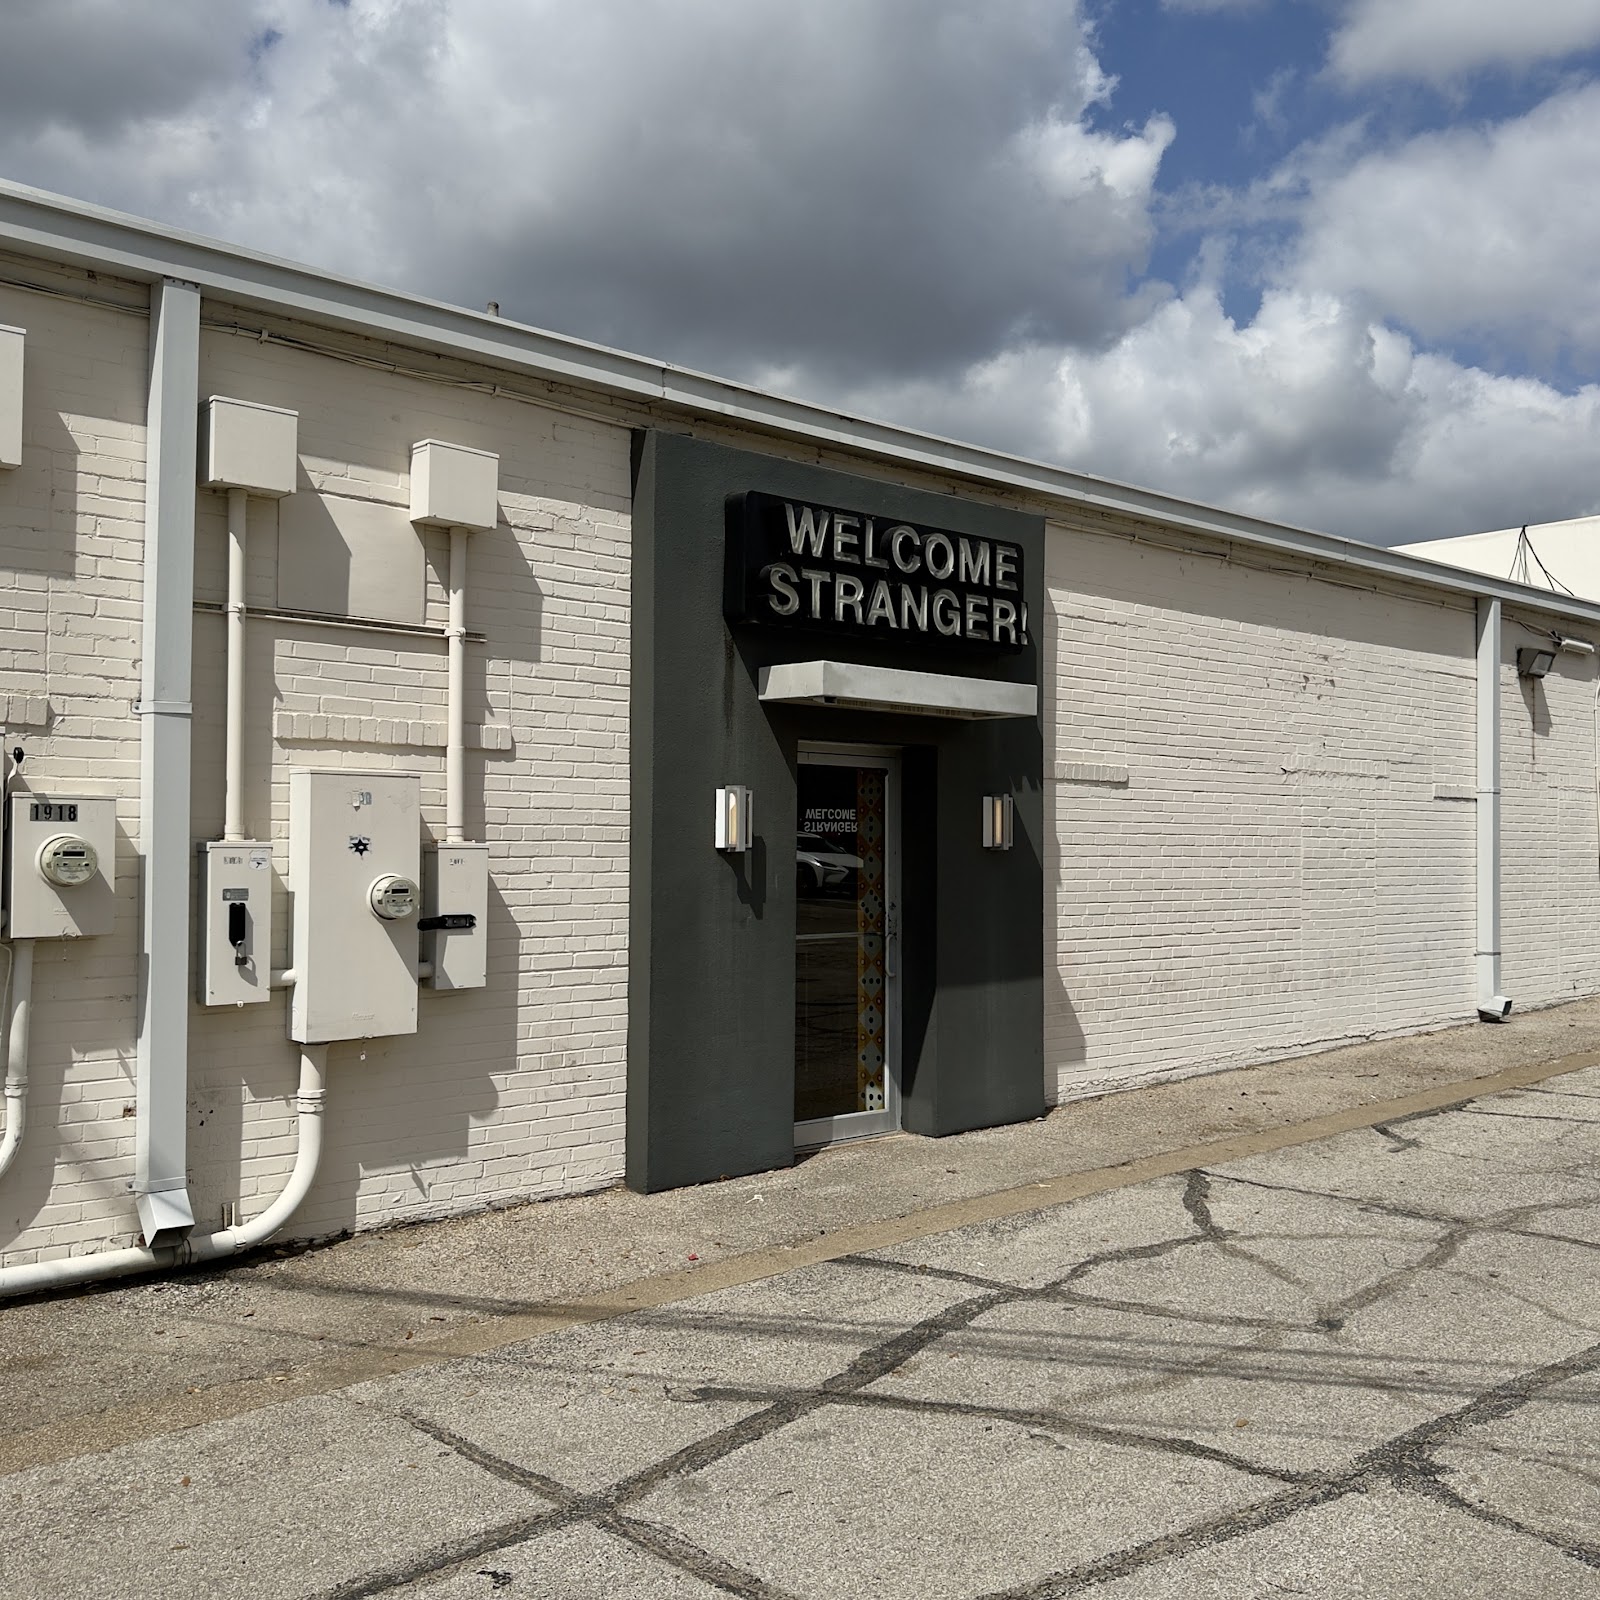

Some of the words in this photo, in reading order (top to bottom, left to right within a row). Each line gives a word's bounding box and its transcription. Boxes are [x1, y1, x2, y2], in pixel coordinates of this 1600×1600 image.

[783, 502, 1018, 591] WELCOME
[767, 562, 1029, 645] STRANGER!
[33, 804, 78, 821] 1918
